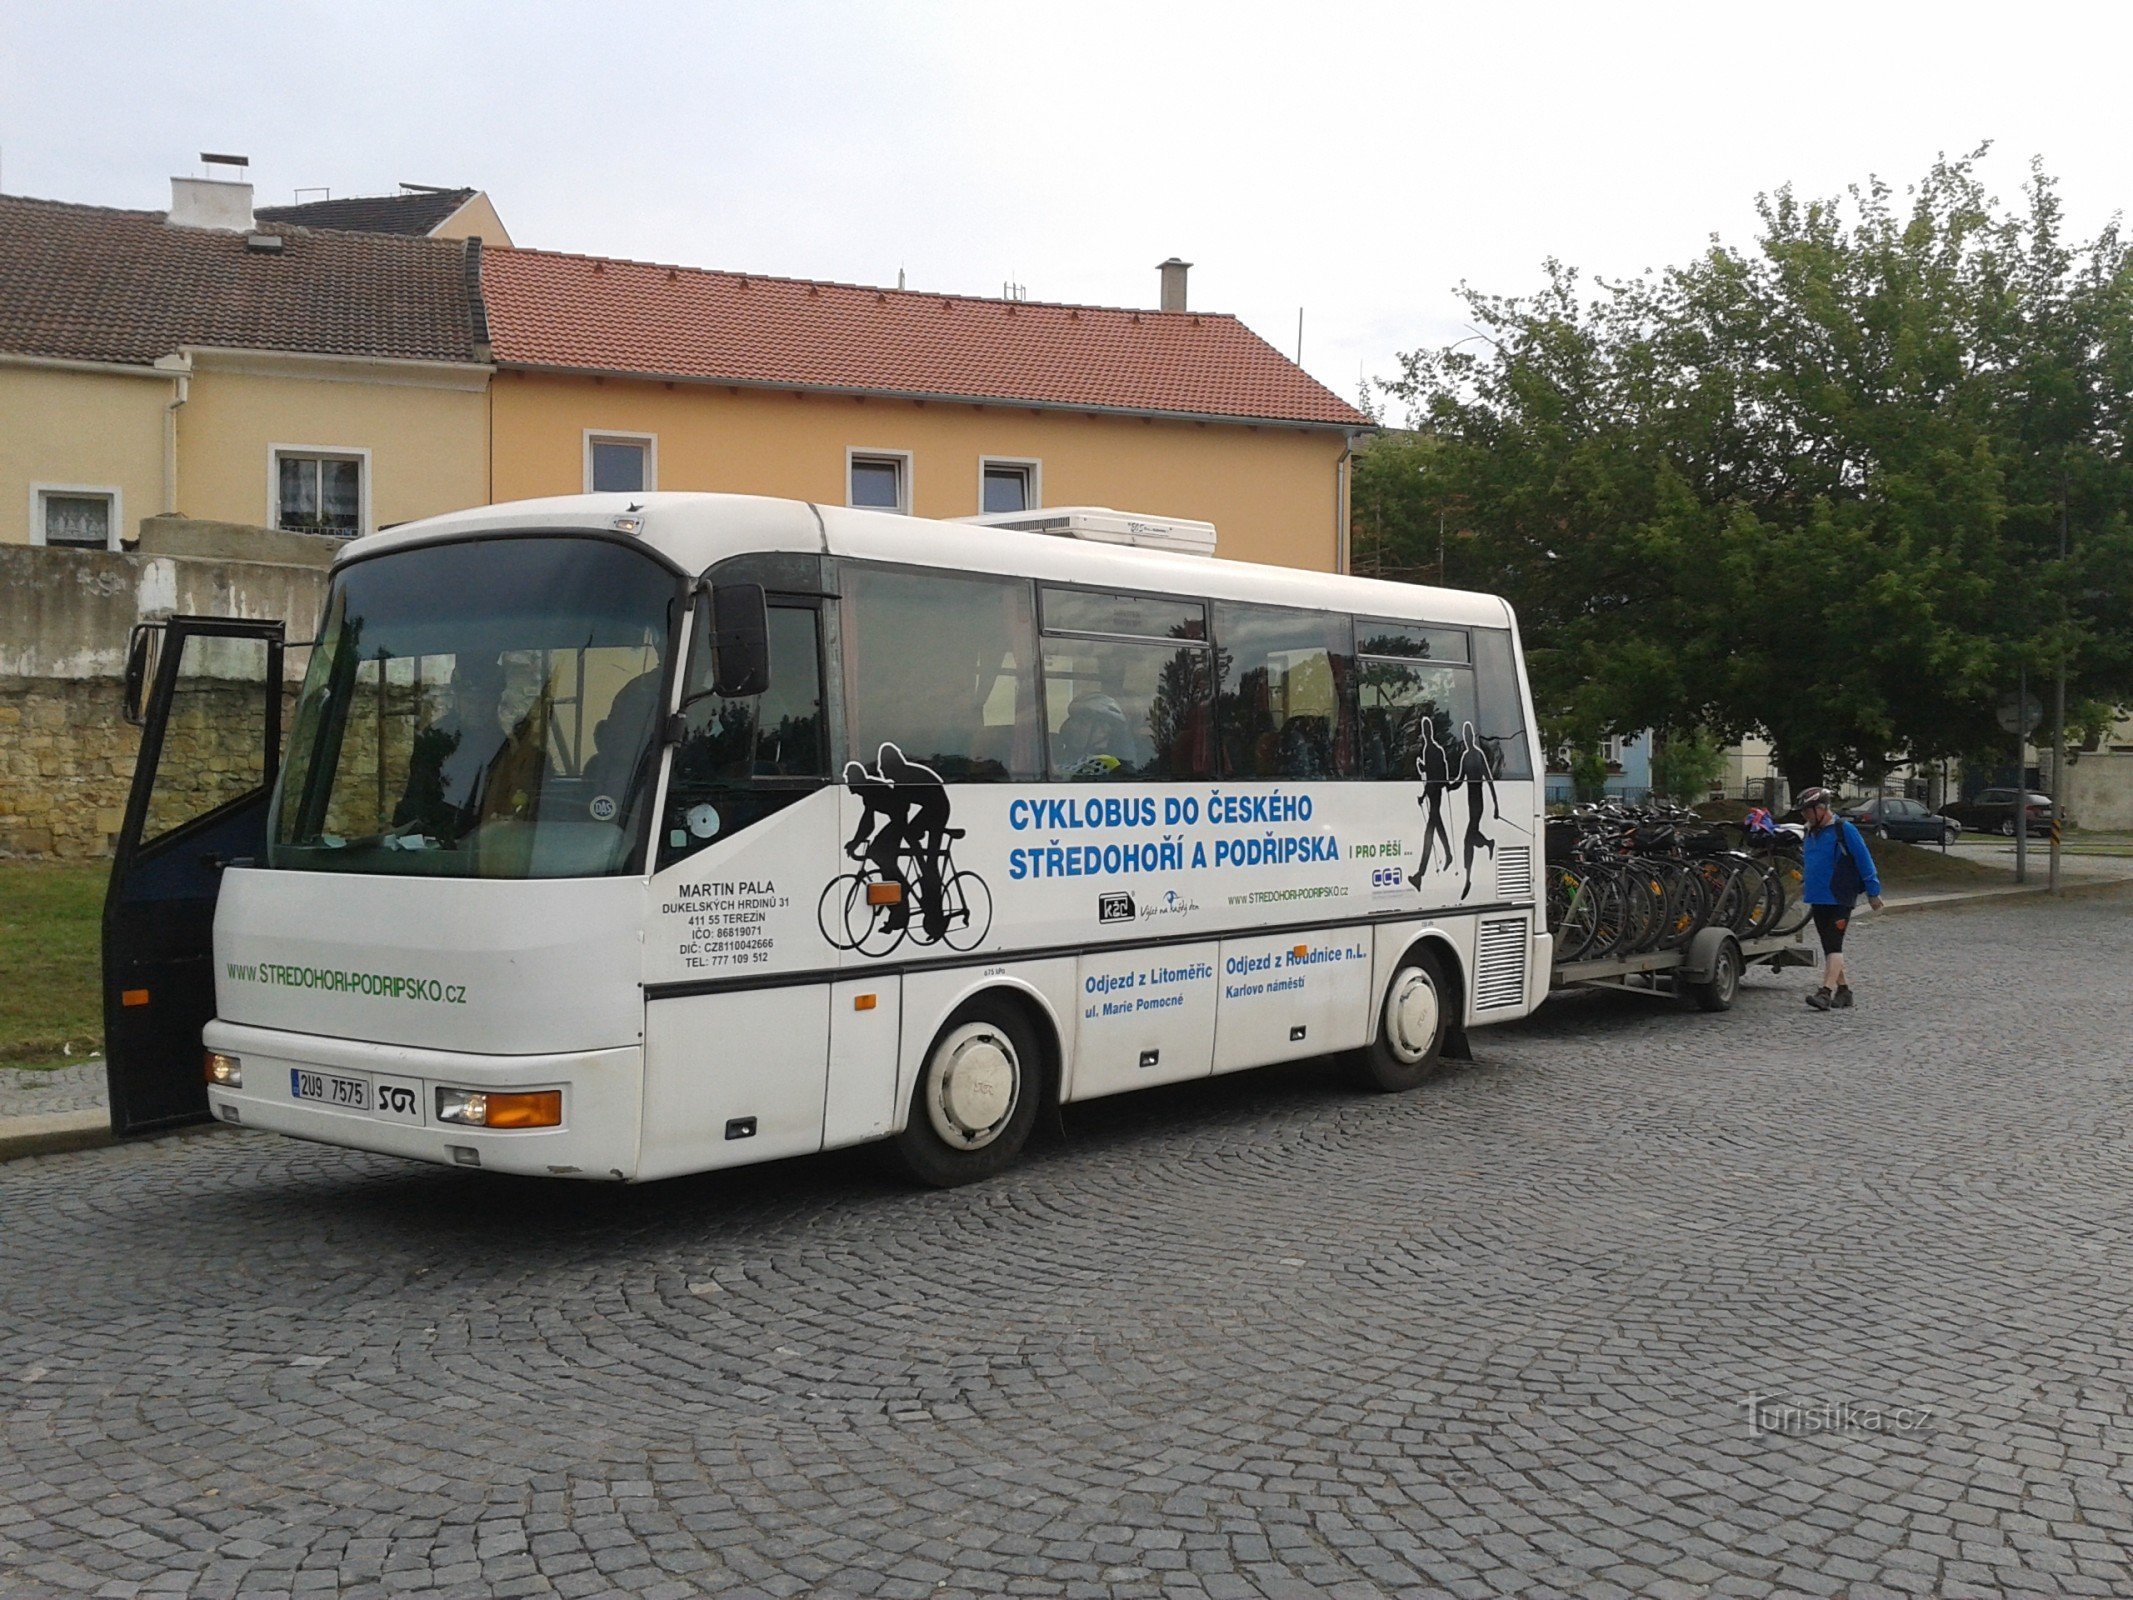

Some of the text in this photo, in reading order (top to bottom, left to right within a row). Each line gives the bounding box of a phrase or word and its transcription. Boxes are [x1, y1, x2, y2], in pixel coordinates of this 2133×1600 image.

[1009, 789, 1313, 831] CYKLOBUS DO ČESKÉHO
[1009, 831, 1340, 879] STŘEDOHOŘÍ A PODŘIPSKA
[1355, 844, 1376, 858] PRO
[1379, 840, 1401, 857] PĚŠÍ
[679, 880, 775, 898] MARTIN PALA
[662, 896, 789, 914] DUKELSKÝCH HRDINŮ 31
[688, 910, 766, 926] 411 55 TEREZÍN
[680, 940, 701, 954] DIČ:
[1225, 952, 1271, 976] Odjezd
[1275, 957, 1282, 968] z
[1345, 943, 1367, 960] n.L.
[685, 952, 768, 968] TEL: 777 109 512
[1085, 963, 1213, 995] Odjezd z Litoměřic
[1226, 975, 1305, 999] Karlovo náměstí
[1085, 993, 1184, 1019] ul. Marie Pomocné
[301, 1074, 364, 1105] 2U9 7575
[379, 1085, 416, 1115] SOR
